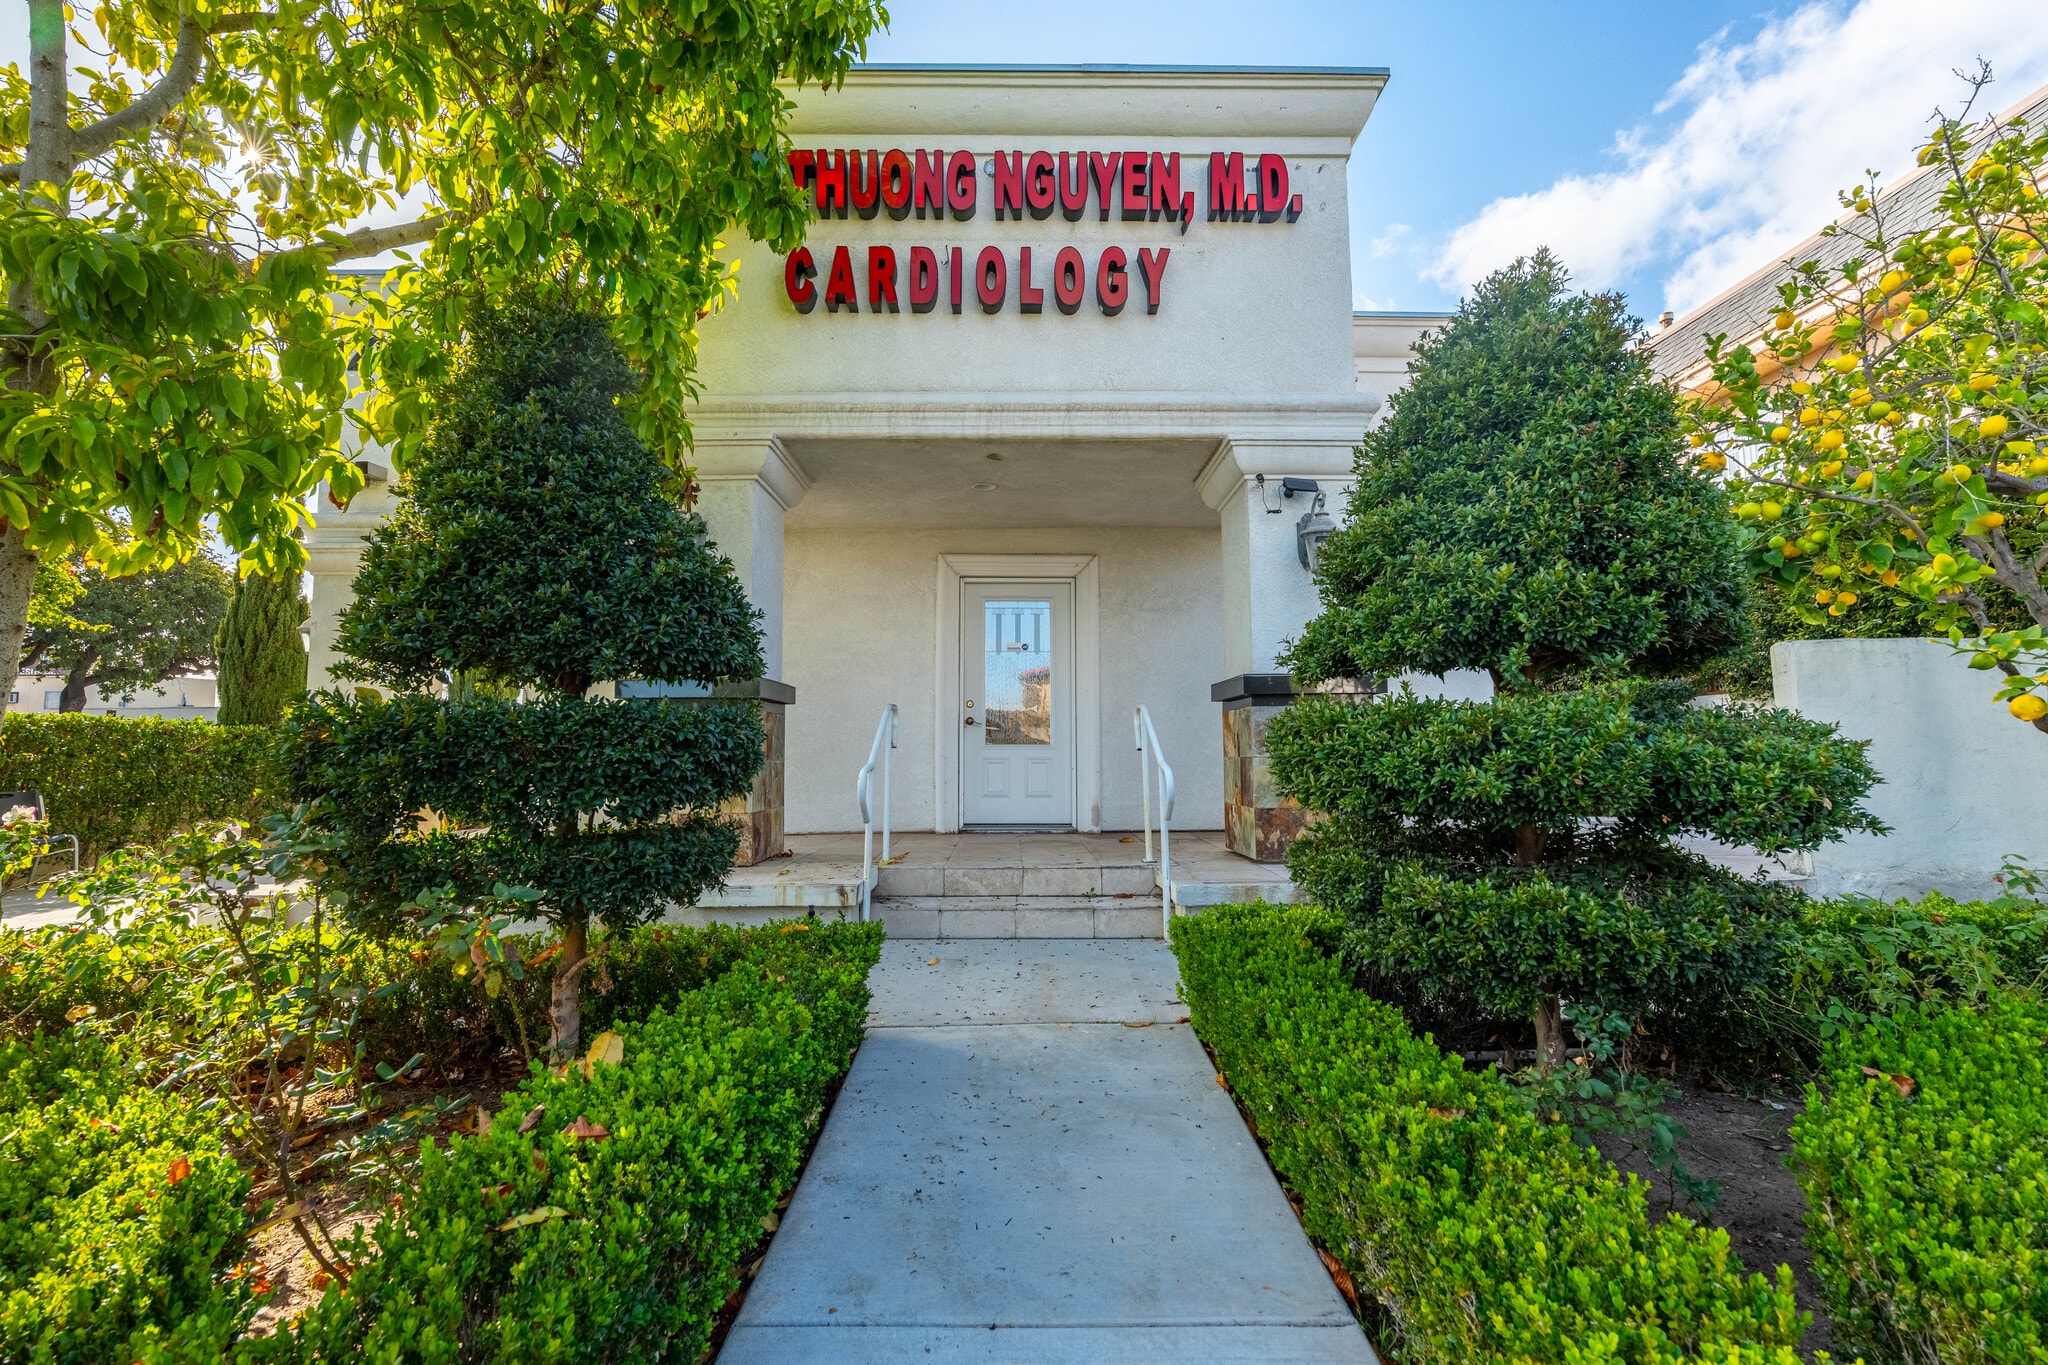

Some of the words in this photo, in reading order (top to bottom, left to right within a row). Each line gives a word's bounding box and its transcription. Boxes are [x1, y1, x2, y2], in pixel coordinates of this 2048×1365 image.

[787, 149, 976, 222] THUONG
[994, 151, 1195, 236] NGUYEN,
[1207, 152, 1303, 224] M.D.
[785, 245, 1171, 316] CARDIOLOGY
